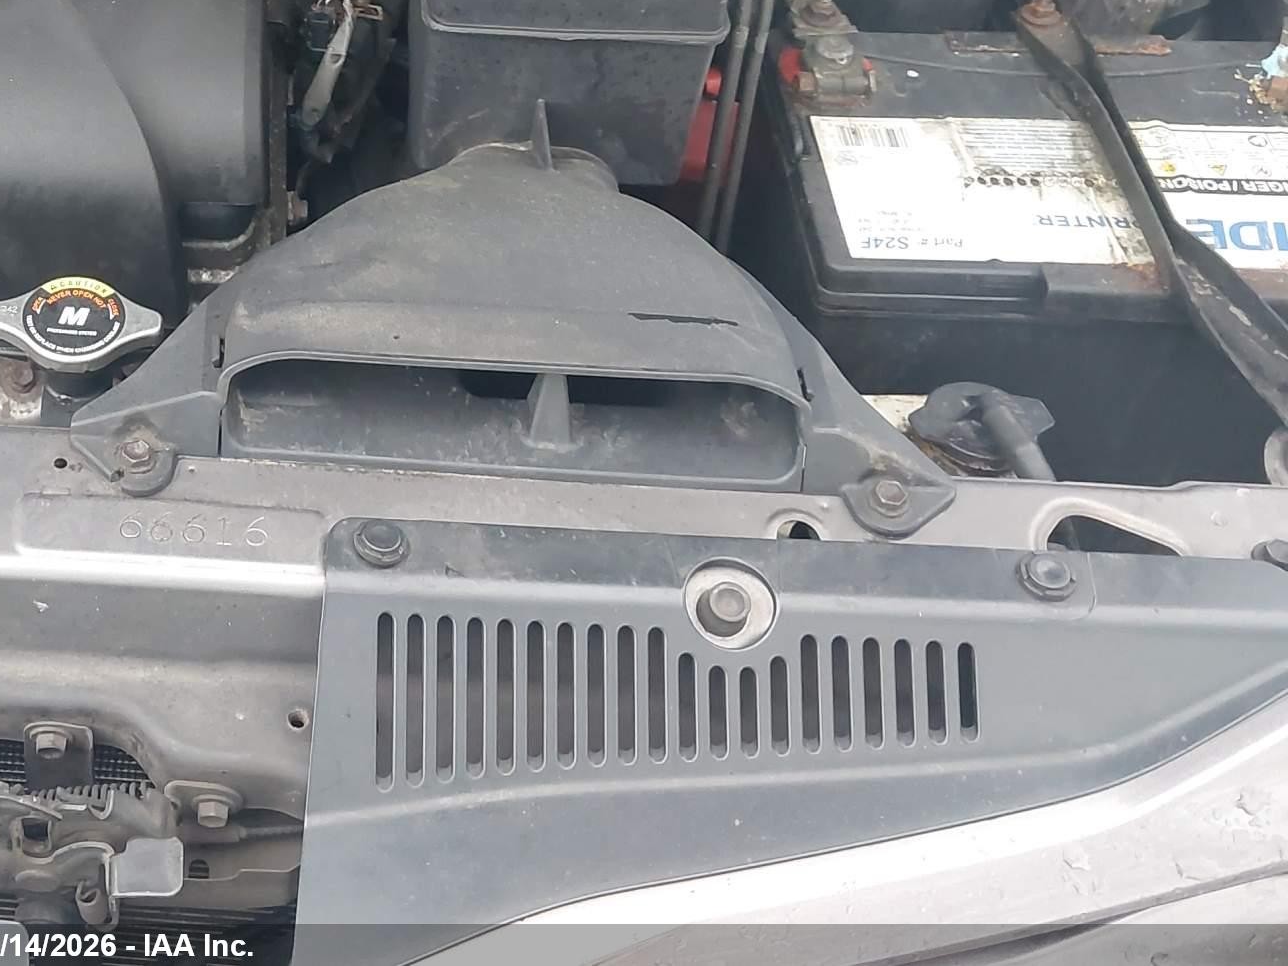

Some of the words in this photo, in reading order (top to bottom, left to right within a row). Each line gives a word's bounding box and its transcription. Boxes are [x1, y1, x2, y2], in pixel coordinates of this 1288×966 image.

[1160, 177, 1232, 192] POISON
[861, 236, 909, 250] S24F
[934, 237, 963, 248] Part
[59, 279, 108, 294] CAUTION
[46, 289, 72, 305] NEVER
[72, 289, 94, 300] OPEN
[57, 306, 91, 326] M
[119, 510, 269, 547] 66616
